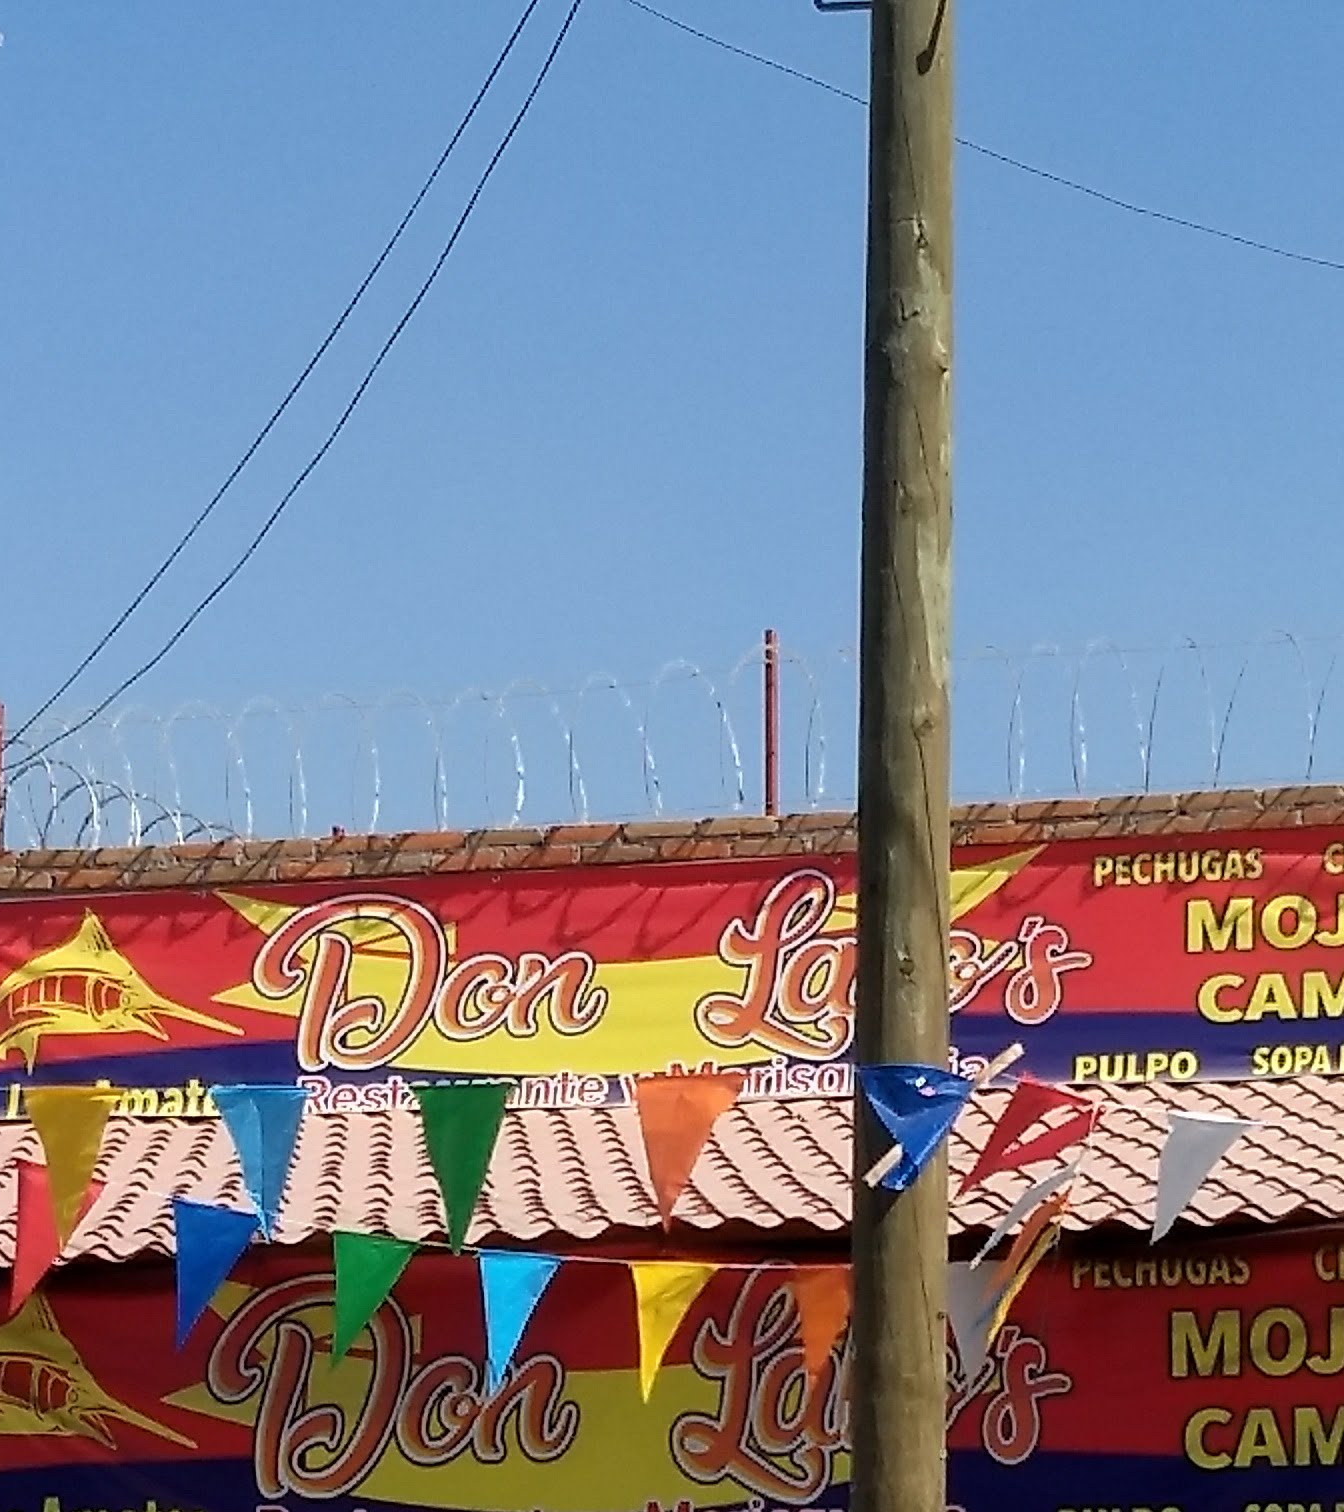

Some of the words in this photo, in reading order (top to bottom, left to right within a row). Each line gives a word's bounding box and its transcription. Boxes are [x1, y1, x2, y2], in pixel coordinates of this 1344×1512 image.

[1092, 849, 1265, 888] PECHUGAS
[252, 890, 608, 1074] Don
[1074, 1050, 1197, 1084] PULPO
[1252, 1043, 1332, 1077] SOPA
[1072, 1252, 1251, 1289] PECHUGAS
[206, 1272, 580, 1500] Don
